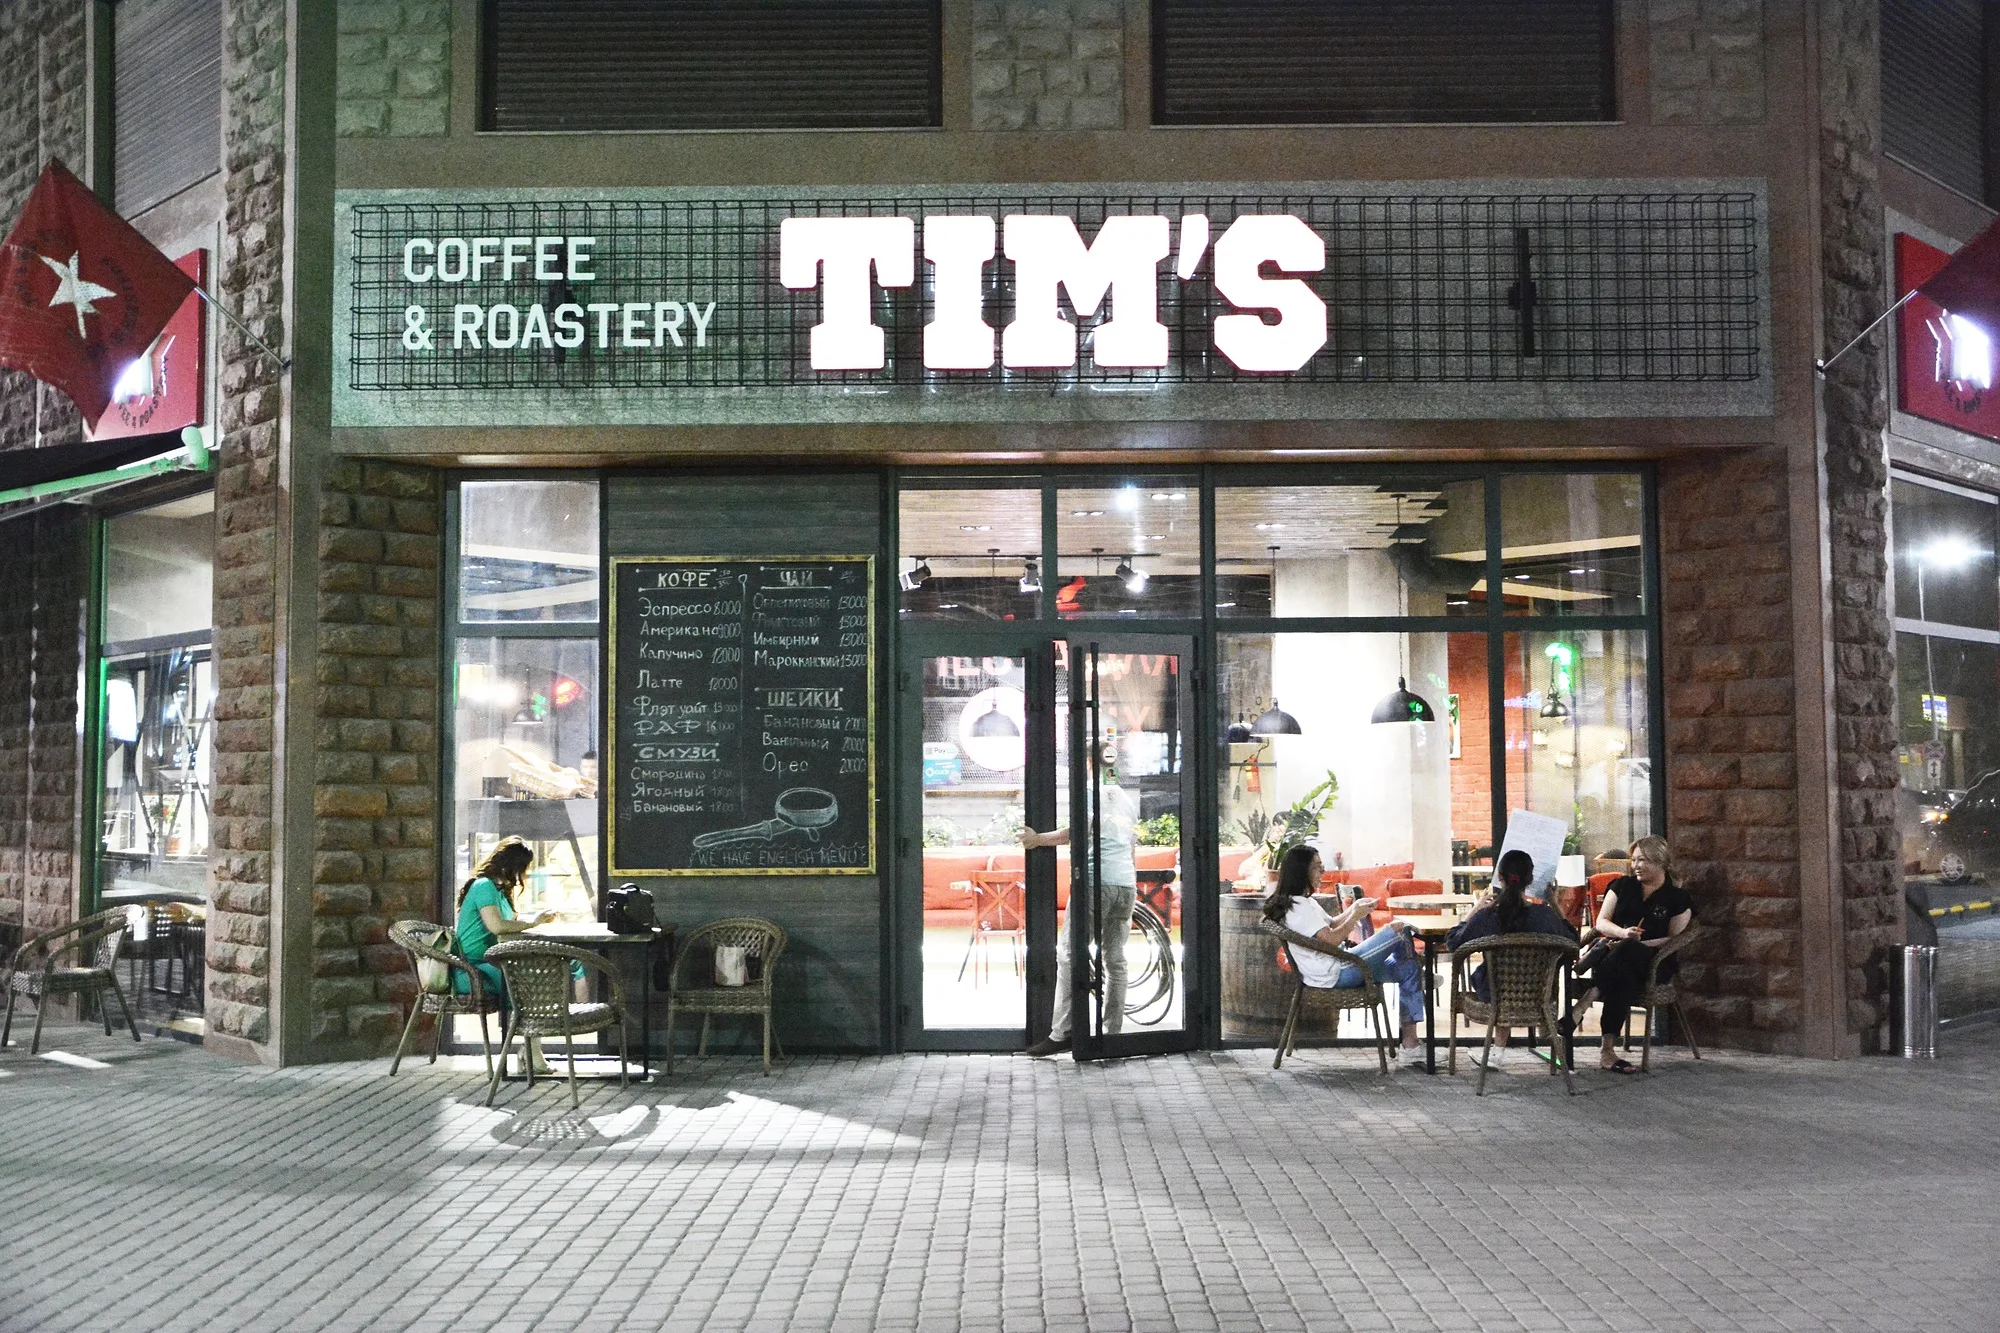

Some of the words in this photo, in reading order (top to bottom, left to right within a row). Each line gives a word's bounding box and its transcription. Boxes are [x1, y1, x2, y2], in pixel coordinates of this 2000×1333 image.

[403, 236, 596, 283] COFFEE
[778, 211, 1328, 372] TIM'S
[402, 304, 435, 350] &
[453, 301, 716, 350] ROASTERY
[657, 571, 711, 588] КОФЕ
[780, 570, 813, 586] ЧАЙ
[638, 596, 712, 620] Эспрессо
[639, 620, 718, 641] Американо
[753, 631, 820, 649] Имбирный
[639, 641, 704, 661] Капучино
[754, 649, 840, 670] Марокканский
[636, 669, 683, 689] Латте
[633, 694, 676, 717] Флэт
[767, 689, 840, 709] ШЕЙКИ
[633, 719, 701, 736] РАФ
[763, 714, 841, 731] Банановый
[638, 745, 717, 760] СМУЗИ
[630, 766, 707, 782] Смородина
[762, 750, 809, 780] Орео
[631, 781, 708, 798] Ягодный
[633, 799, 704, 813] Банановый
[723, 850, 752, 866] HAVE
[759, 849, 816, 867] ENGLISH
